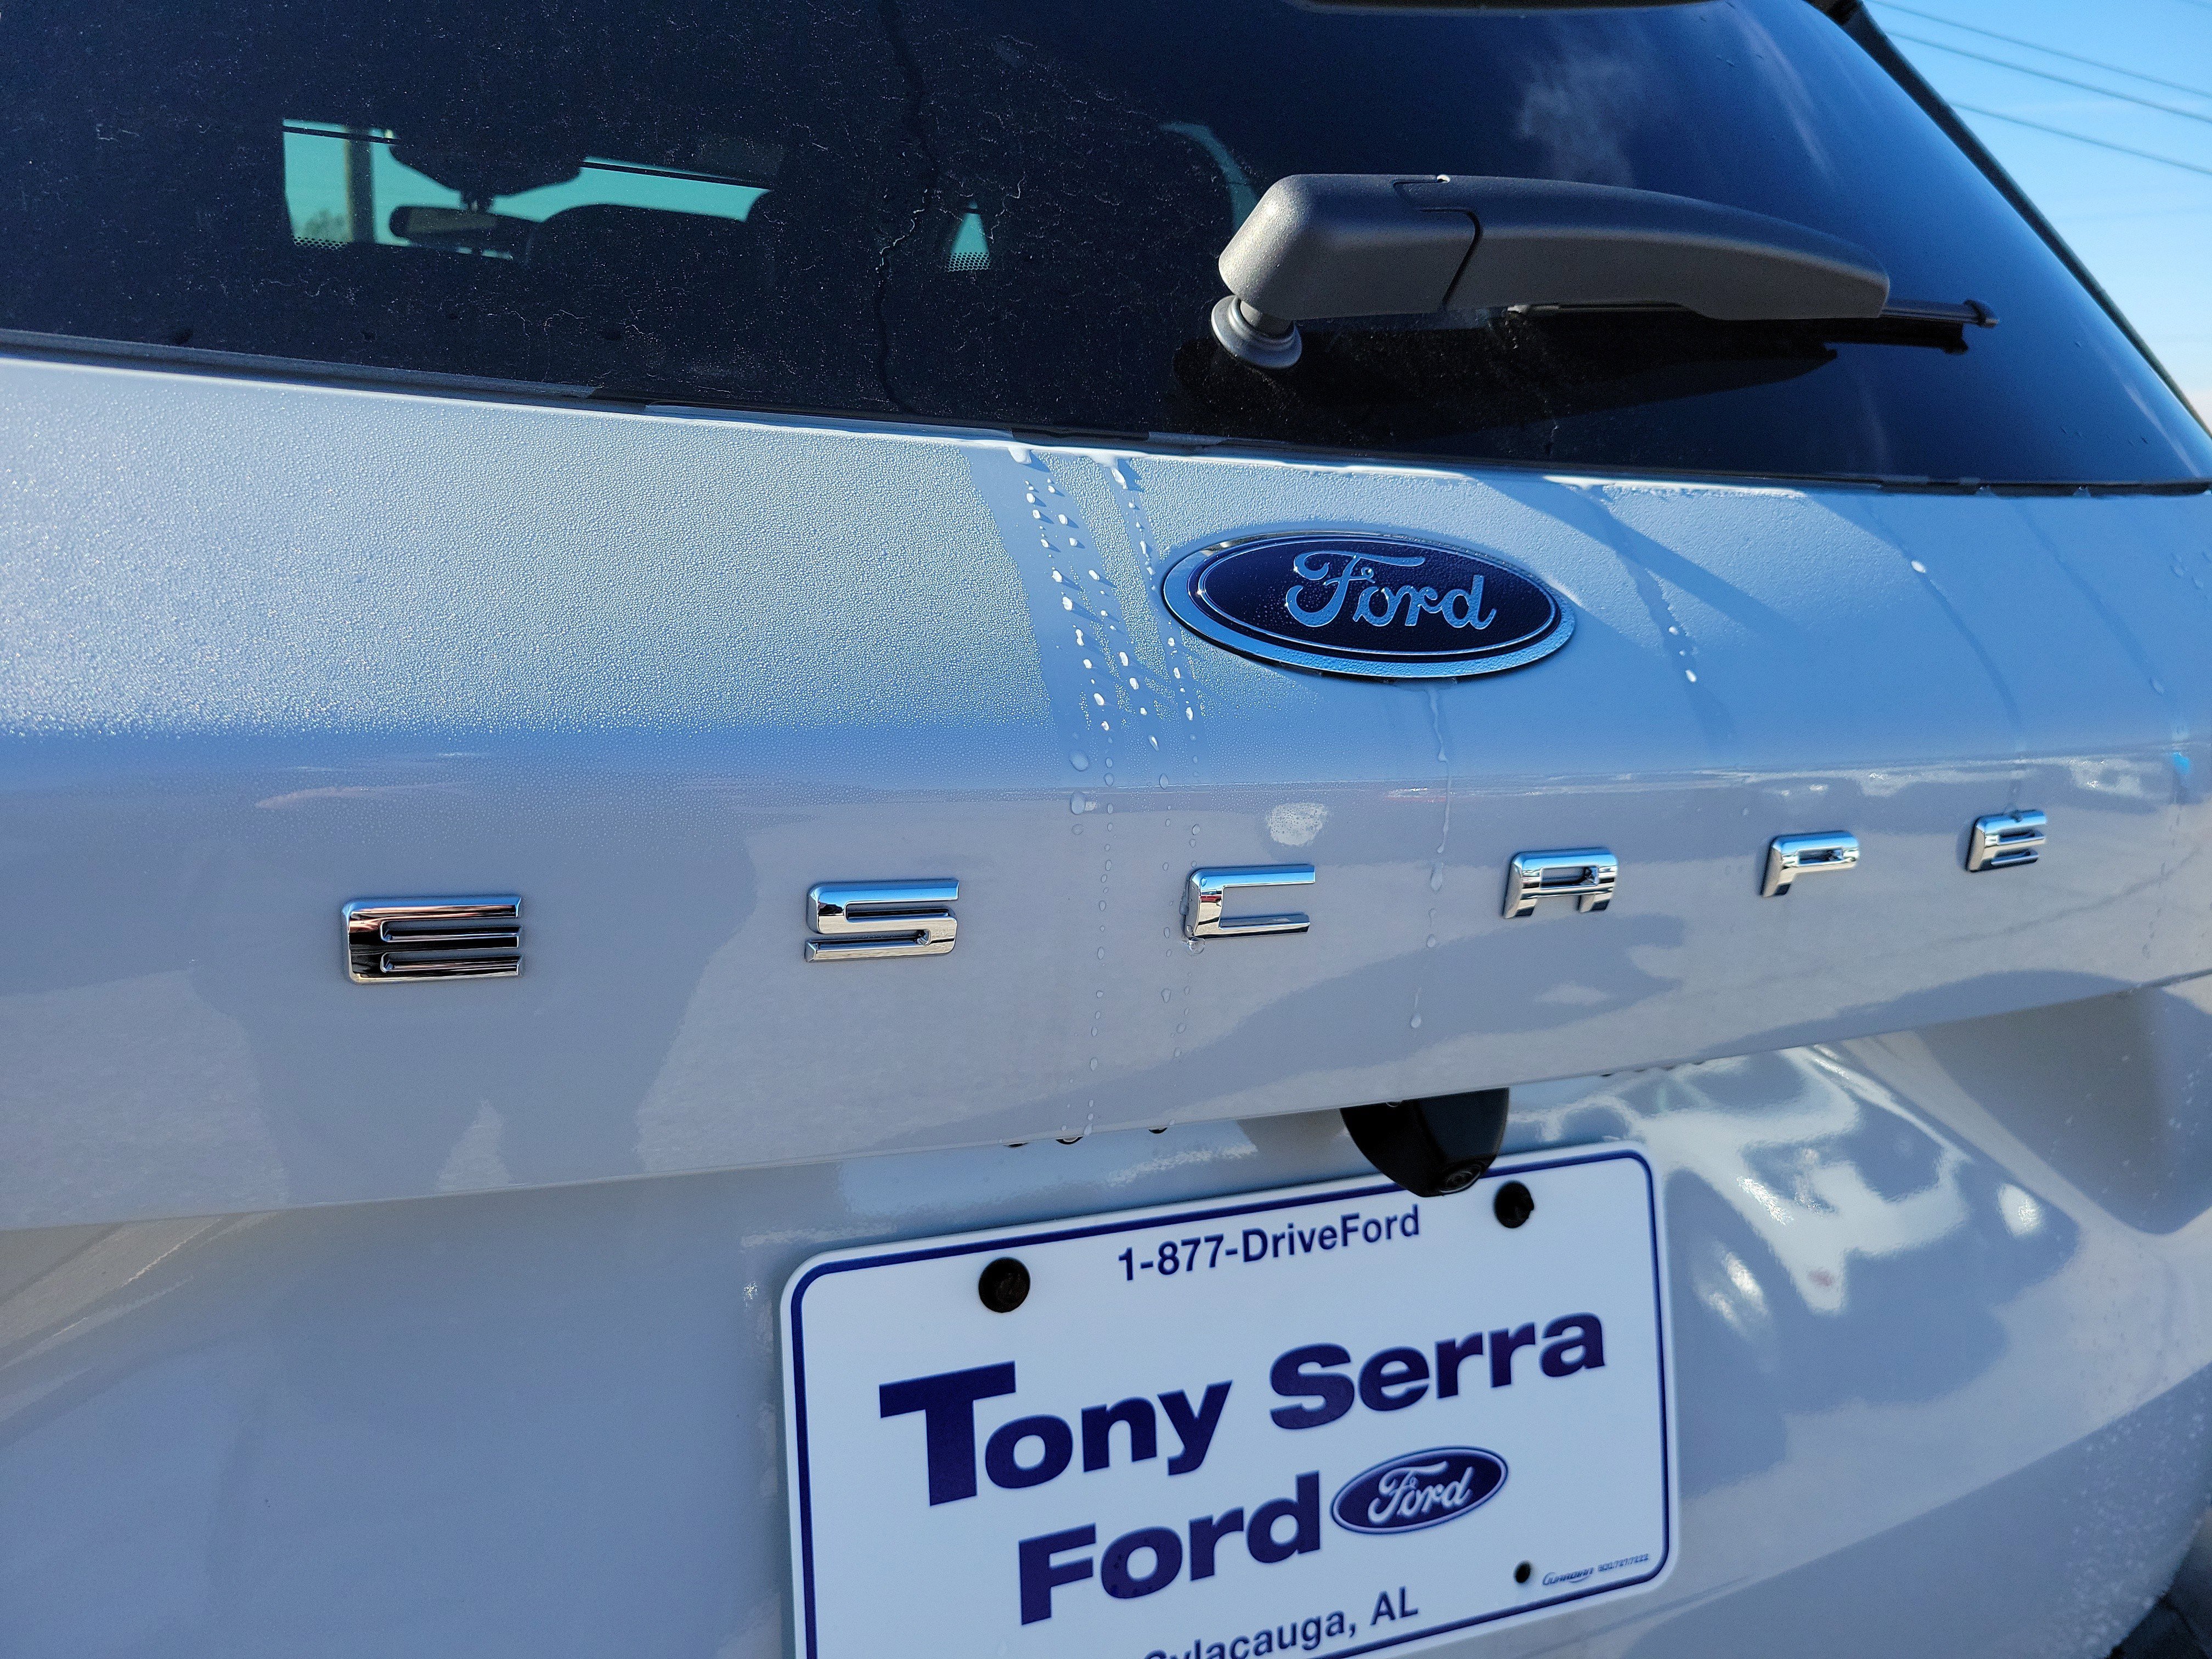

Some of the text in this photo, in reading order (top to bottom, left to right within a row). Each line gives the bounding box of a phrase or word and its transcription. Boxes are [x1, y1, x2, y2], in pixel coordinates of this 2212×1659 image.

[1285, 550, 1497, 630] Ford
[341, 809, 2047, 985] ESCAPE
[1118, 1204, 1420, 1281] 1-877-DriveFord
[879, 1312, 1605, 1506] Tony Serra
[1367, 1460, 1476, 1525] Ford
[1018, 1469, 1321, 1626] Ford
[1144, 1586, 1419, 1659] lacauga, AL
